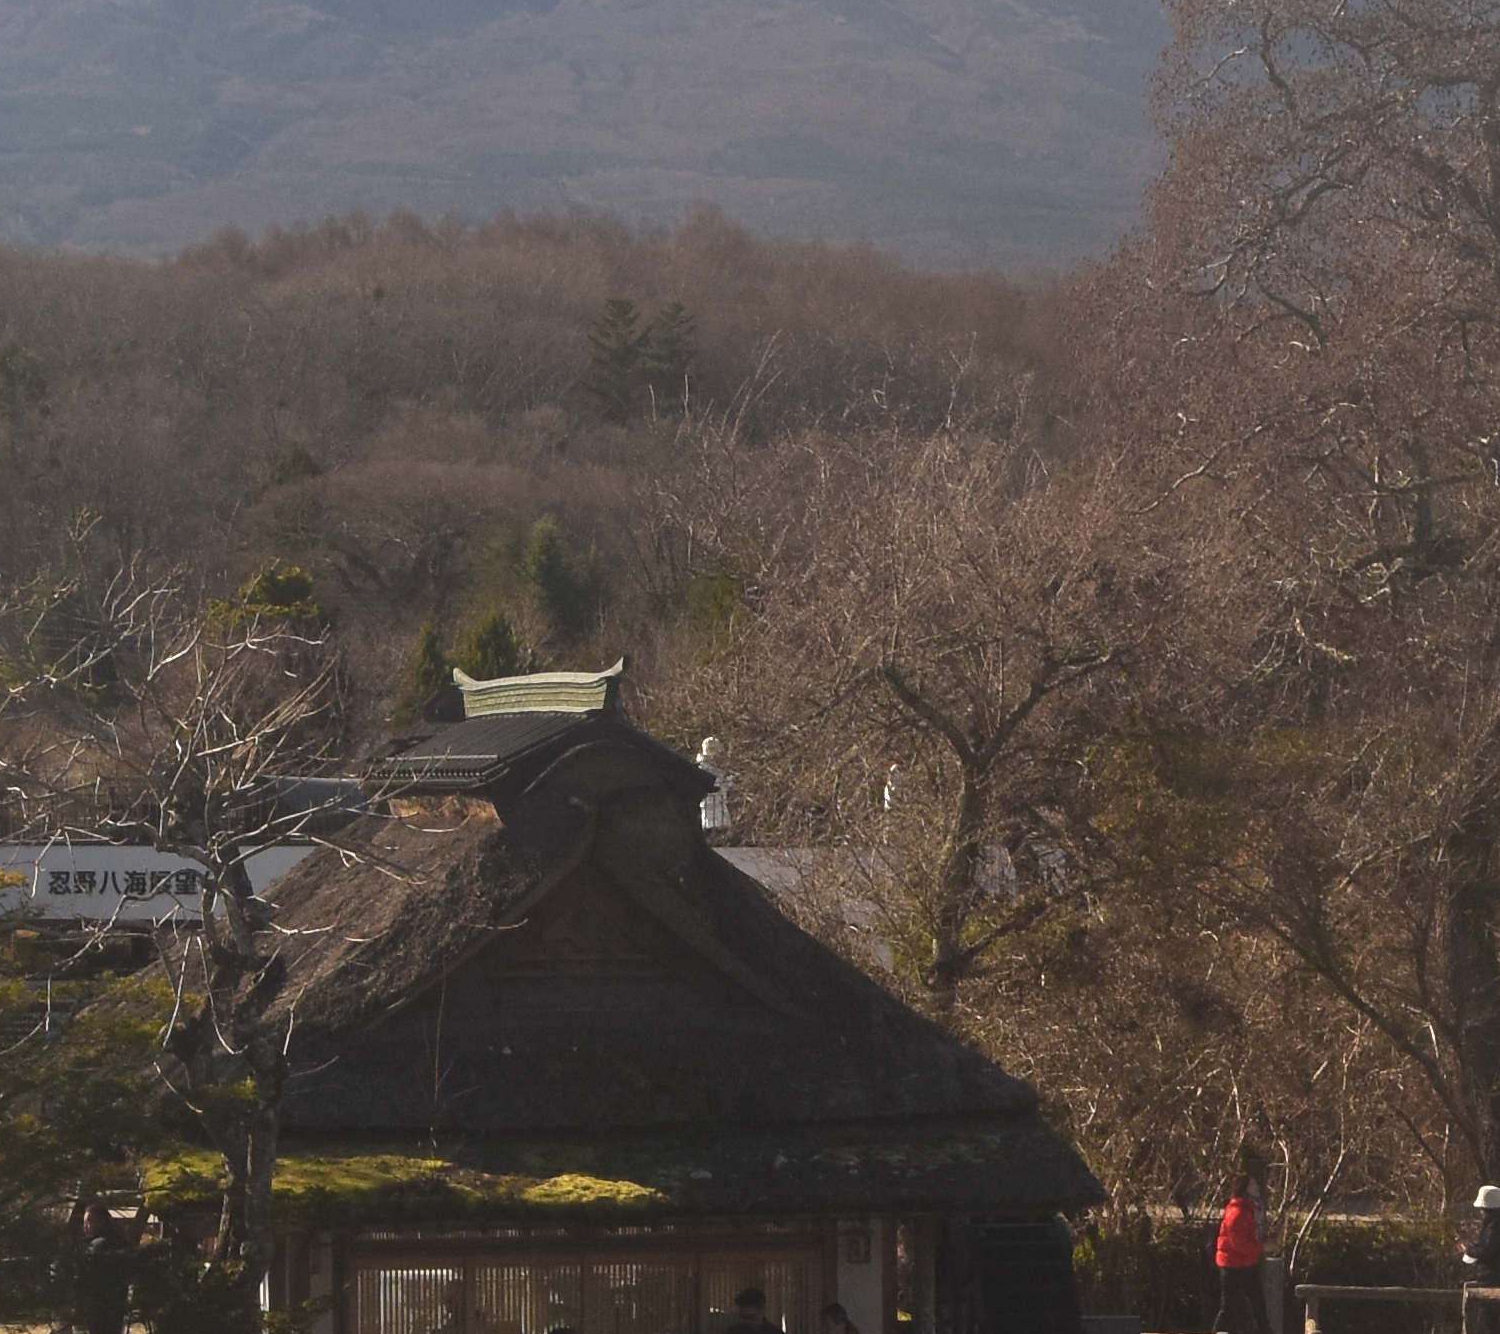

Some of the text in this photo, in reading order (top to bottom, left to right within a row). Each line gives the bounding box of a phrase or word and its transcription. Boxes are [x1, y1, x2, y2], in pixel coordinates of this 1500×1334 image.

[48, 870, 214, 895] 忍野八海展望
